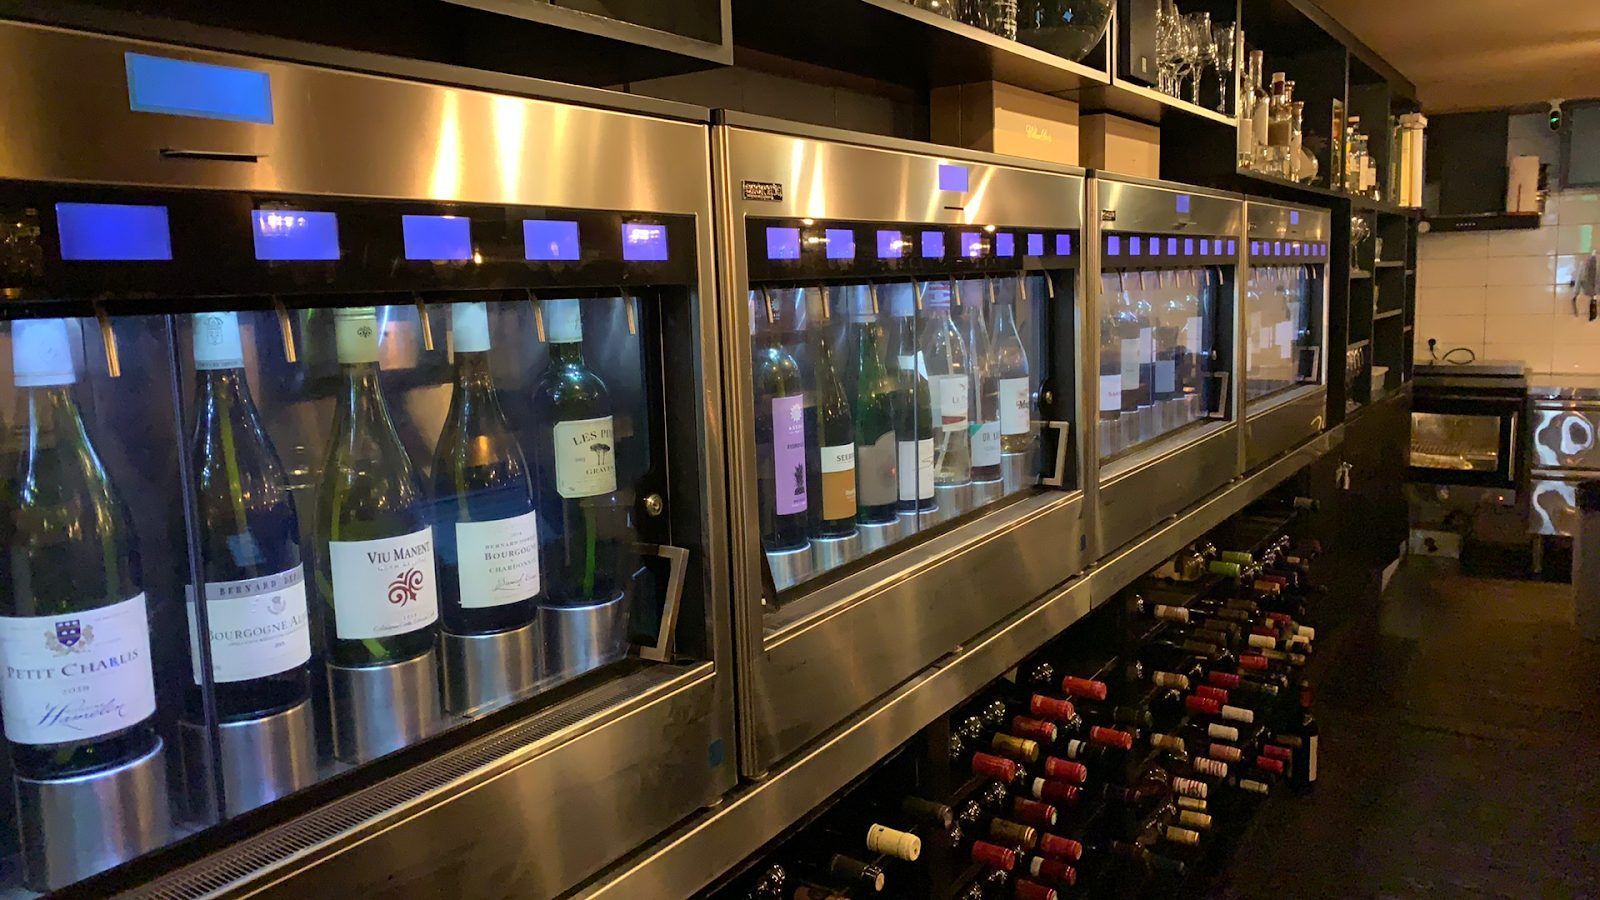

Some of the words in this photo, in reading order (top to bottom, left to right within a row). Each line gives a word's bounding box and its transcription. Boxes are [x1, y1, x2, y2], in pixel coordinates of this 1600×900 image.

[573, 430, 597, 446] LES
[367, 551, 391, 564] VIU
[393, 541, 430, 561] MANENT
[219, 580, 277, 596] BERNARD
[209, 619, 289, 641] BOURGOGNE
[7, 666, 55, 680] PETIT
[61, 649, 139, 677] CHABLIS
